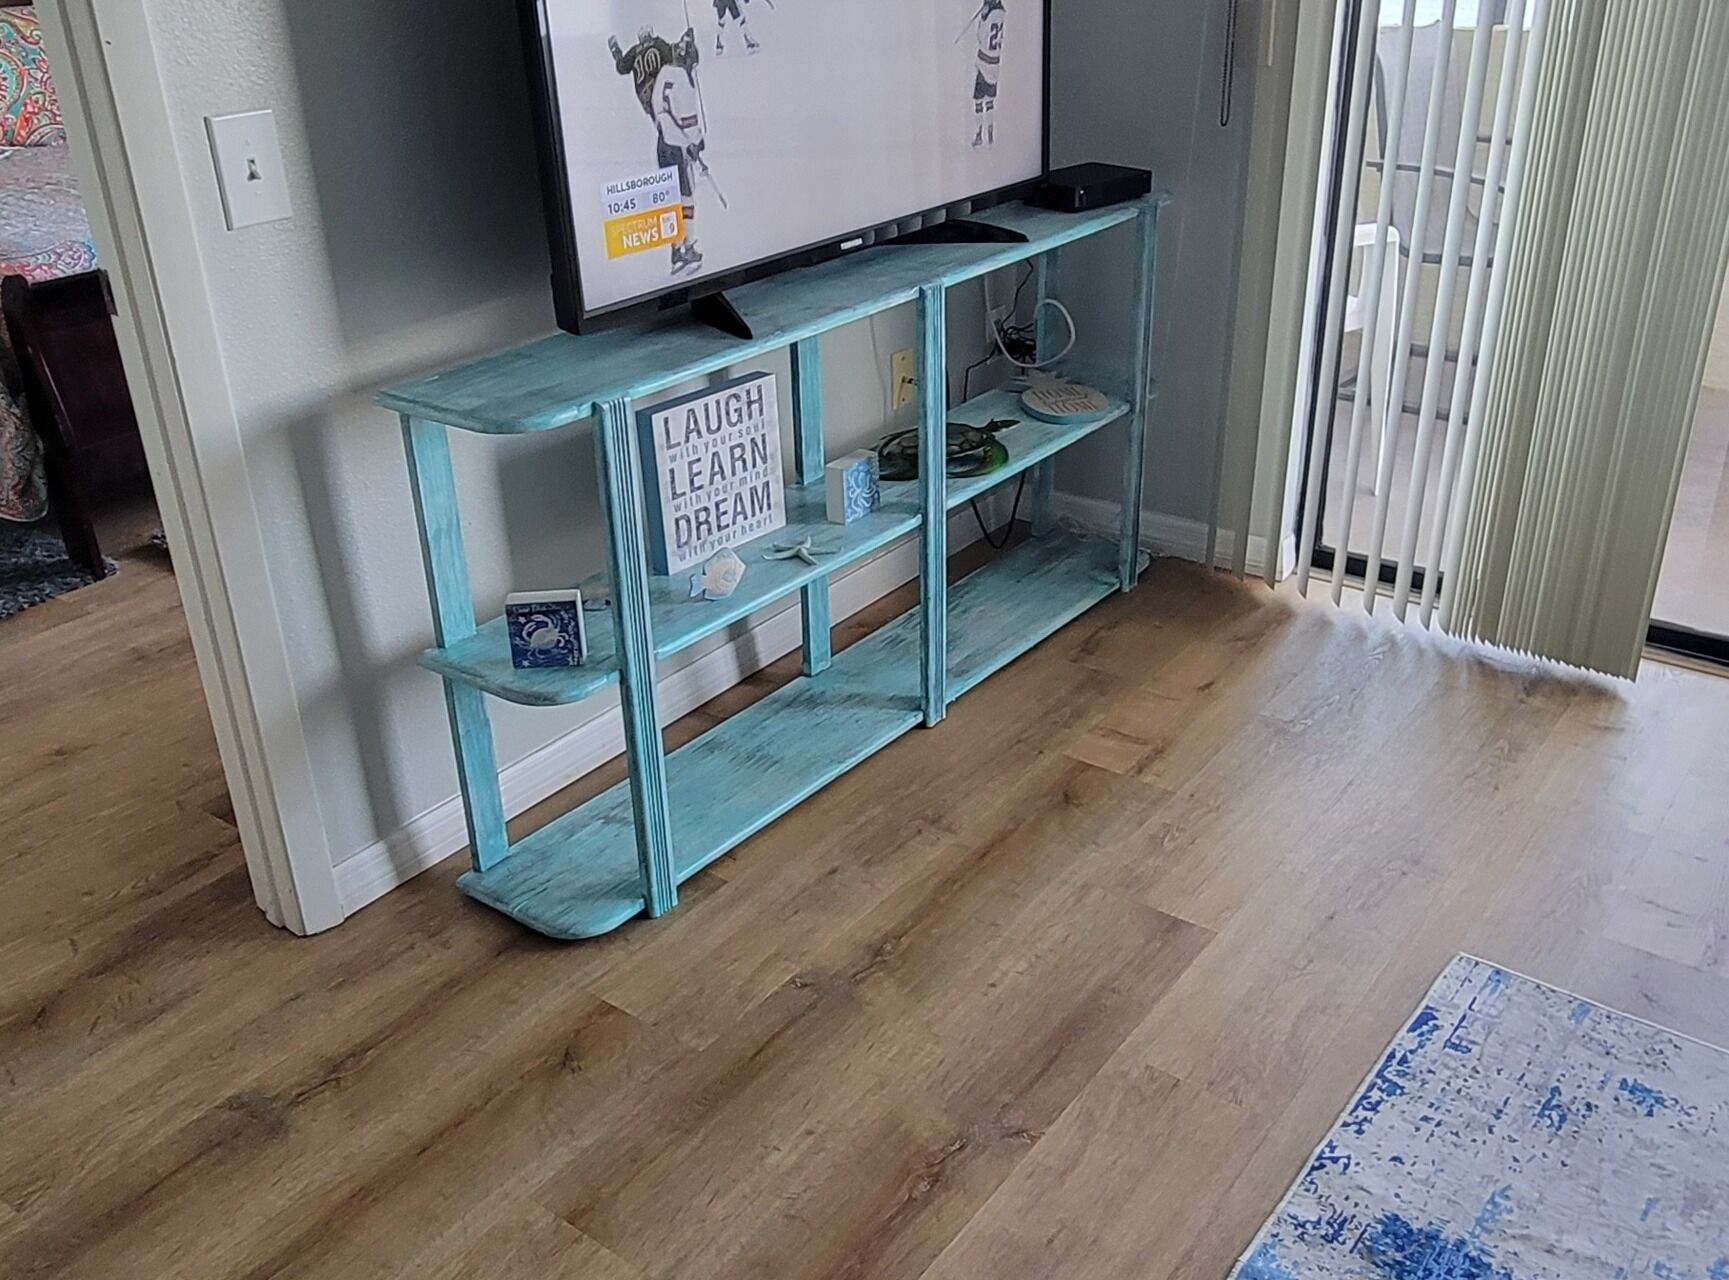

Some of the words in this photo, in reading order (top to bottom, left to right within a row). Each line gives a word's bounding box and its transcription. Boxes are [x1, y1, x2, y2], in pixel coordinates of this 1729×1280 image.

[606, 172, 673, 195] HILLSBOROUGH
[607, 198, 636, 215] 10:45
[623, 228, 659, 249] NEWS
[663, 384, 764, 451] LAUGH
[668, 443, 698, 464] with
[704, 432, 732, 454] your
[738, 419, 765, 438] soul
[668, 433, 768, 501] LEARN
[673, 493, 701, 513] with
[707, 481, 734, 502] your
[739, 466, 769, 487] mind
[674, 480, 772, 549] DREAM
[677, 540, 705, 562] with
[708, 530, 737, 550] your
[741, 514, 773, 535] heart
